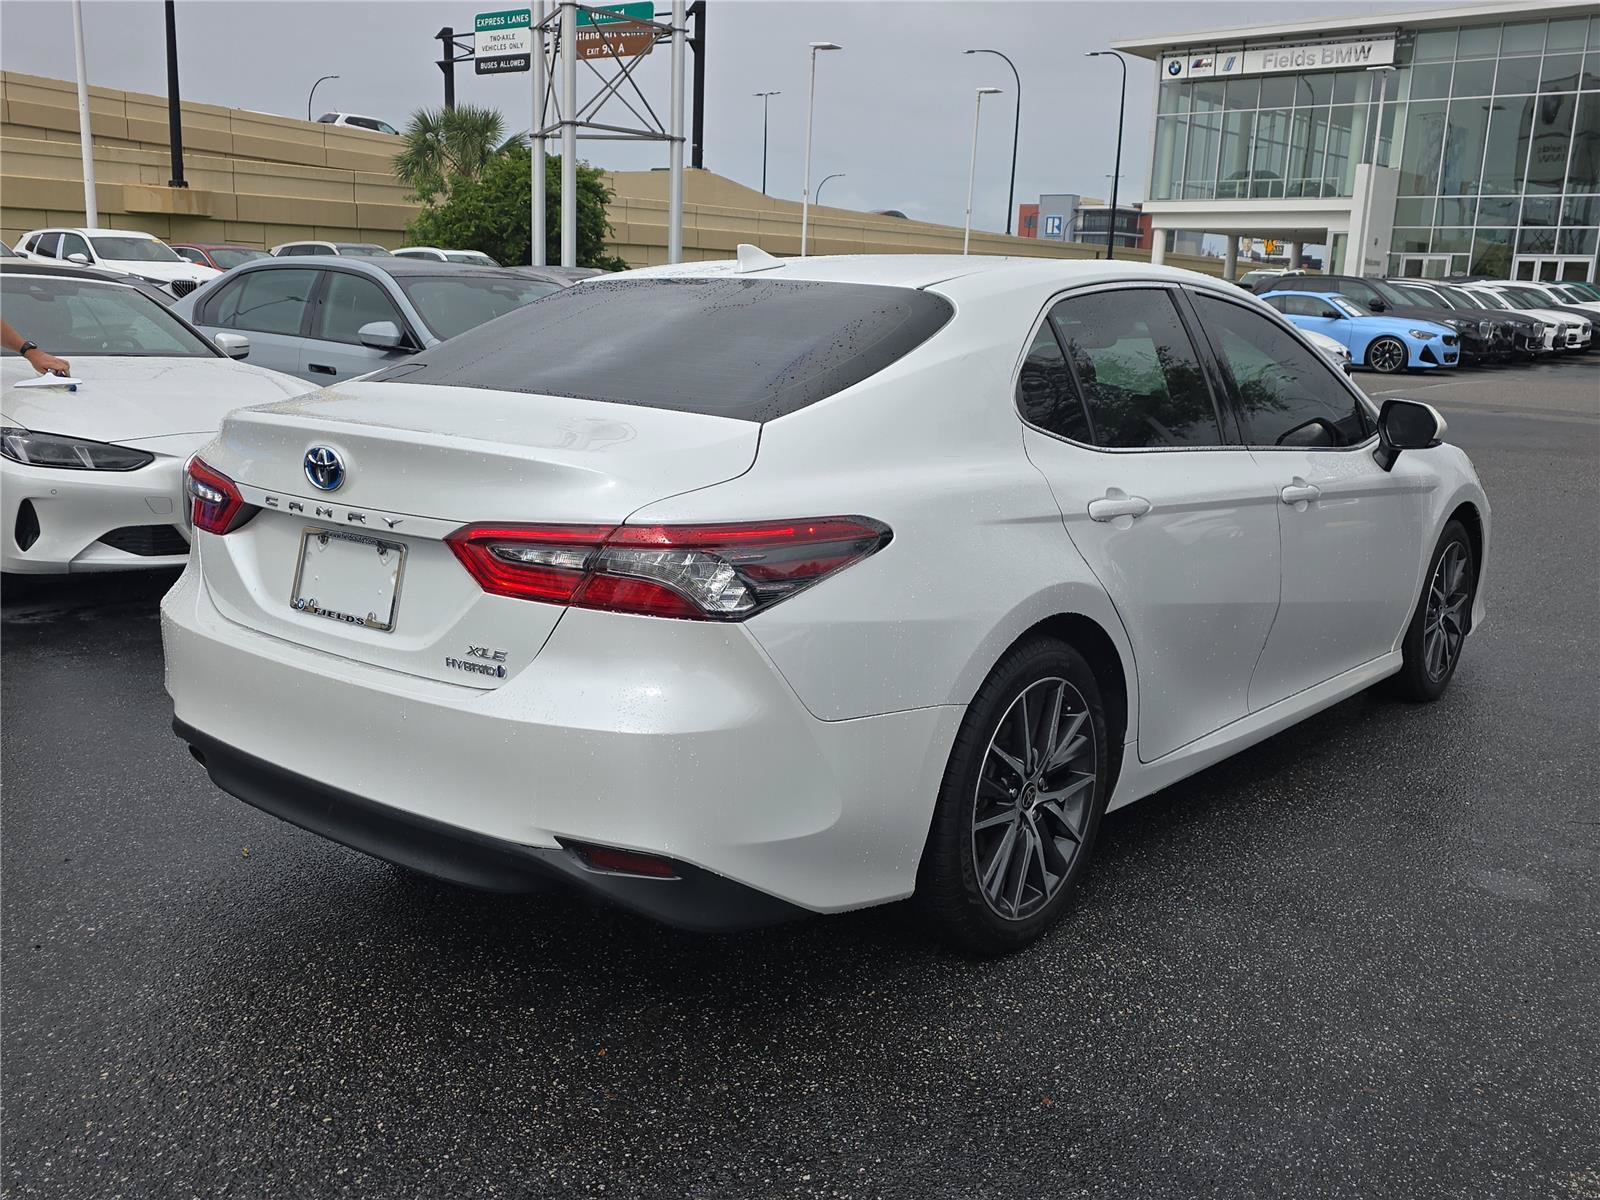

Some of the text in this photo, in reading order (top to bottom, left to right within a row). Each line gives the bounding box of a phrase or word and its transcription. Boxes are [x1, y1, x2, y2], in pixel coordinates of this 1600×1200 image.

[476, 14, 529, 27] EXPRESS LANES
[490, 33, 516, 42] TWO-AXLE
[482, 43, 507, 51] VEHICLES
[618, 43, 625, 53] A
[480, 59, 526, 69] BUSES ALLOWED
[1262, 44, 1373, 69] Fields BMW
[265, 496, 404, 528] CAMRY
[314, 607, 365, 625] FIELDS
[465, 645, 508, 662] XLE
[445, 657, 497, 677] HYBRID
